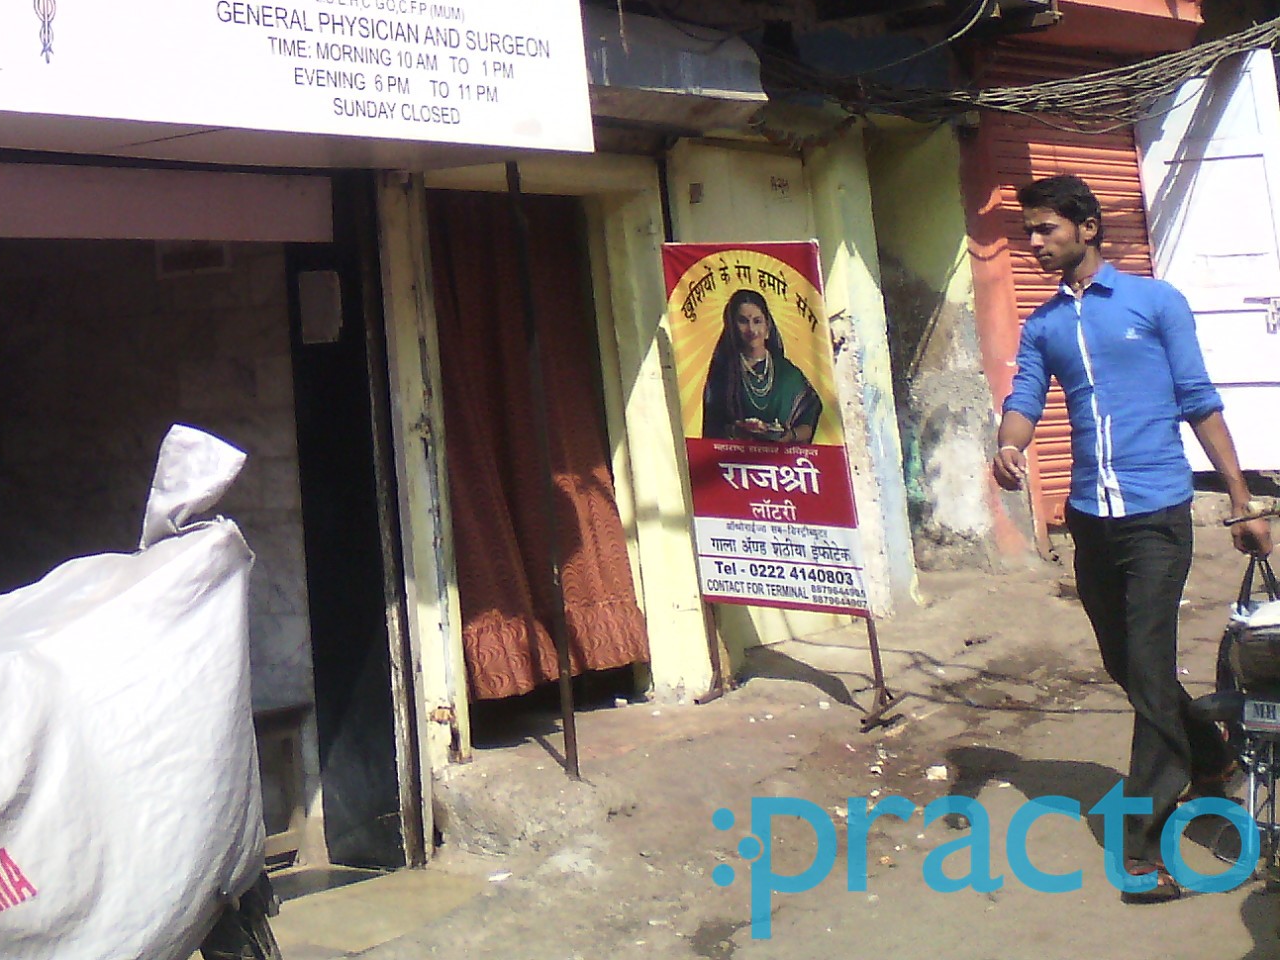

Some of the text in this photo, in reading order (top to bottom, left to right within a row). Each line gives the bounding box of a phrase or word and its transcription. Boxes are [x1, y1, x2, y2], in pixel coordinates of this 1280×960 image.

[217, 0, 551, 59] GENERAL PHYSICIAN AND SURGEON
[268, 36, 515, 80] TIME: MORNING 10 AM TO 1 PM
[294, 67, 499, 103] EVENING 6 PM TO 11 PM
[333, 97, 461, 126] SUNDAY CLOSED
[681, 258, 819, 333] खुशियों के रंग हमारे संग
[718, 457, 821, 495] राजश्री
[749, 499, 797, 521] लॉटरी
[710, 537, 737, 553] गाला
[706, 578, 745, 593] CONTACT
[747, 582, 765, 595] FOR
[766, 583, 809, 600] TERMINAL
[714, 561, 737, 576] Tel
[749, 563, 786, 580] 0222
[789, 566, 854, 586] 4140803
